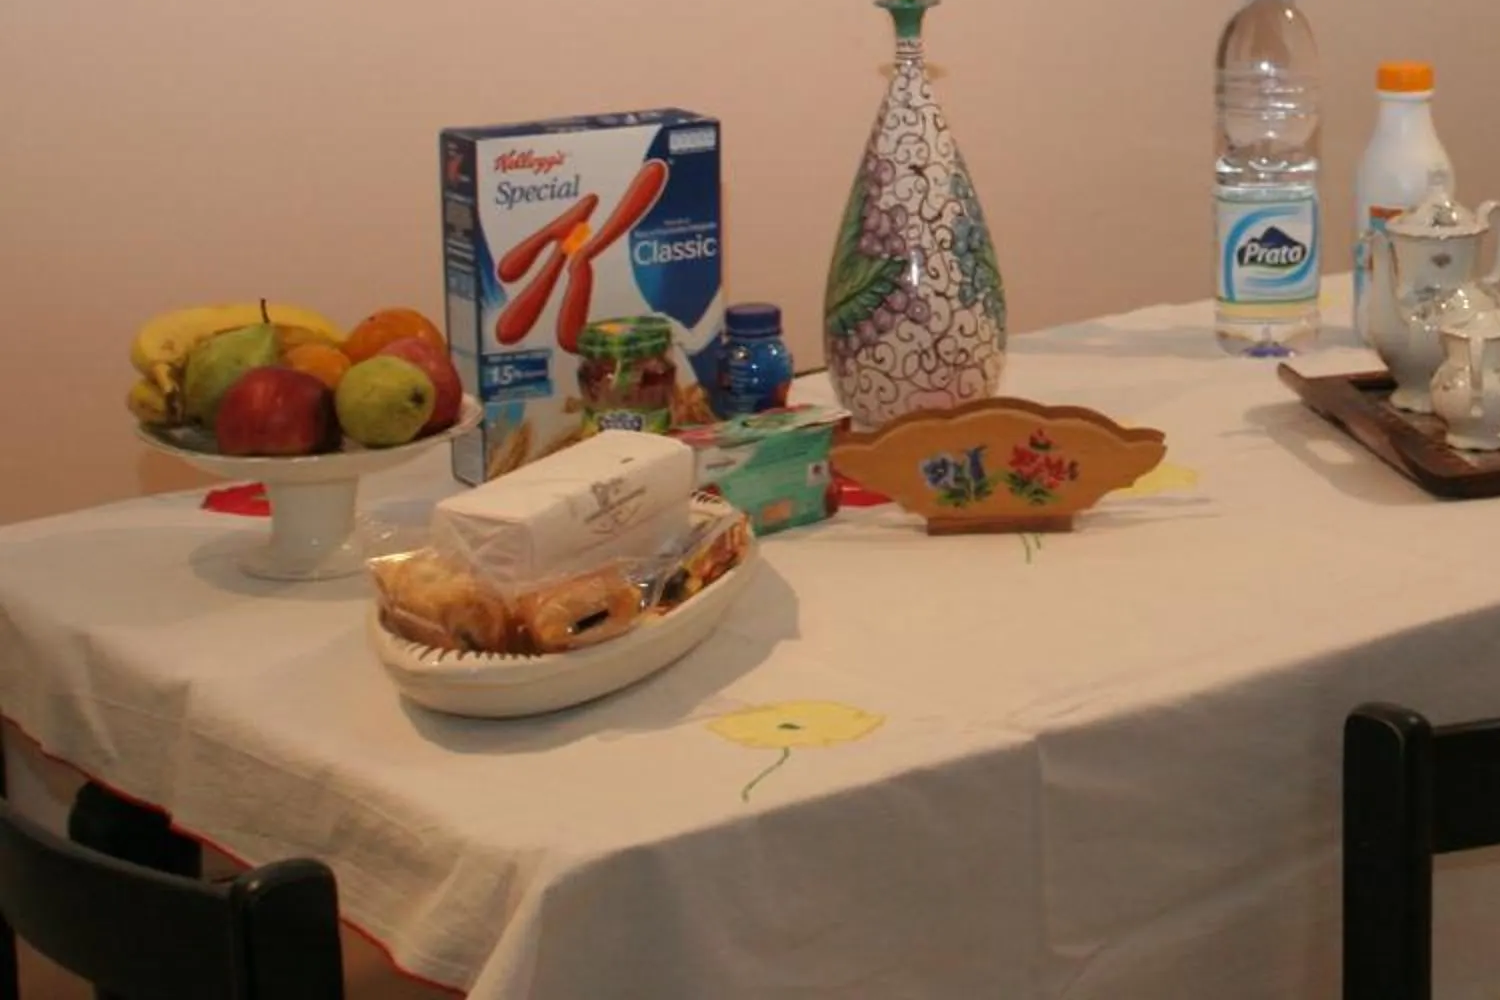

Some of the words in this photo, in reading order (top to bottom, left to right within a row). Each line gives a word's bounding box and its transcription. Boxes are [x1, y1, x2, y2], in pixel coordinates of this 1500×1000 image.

[495, 174, 580, 210] Special
[634, 233, 717, 265] Classic
[1243, 242, 1303, 265] Prato
